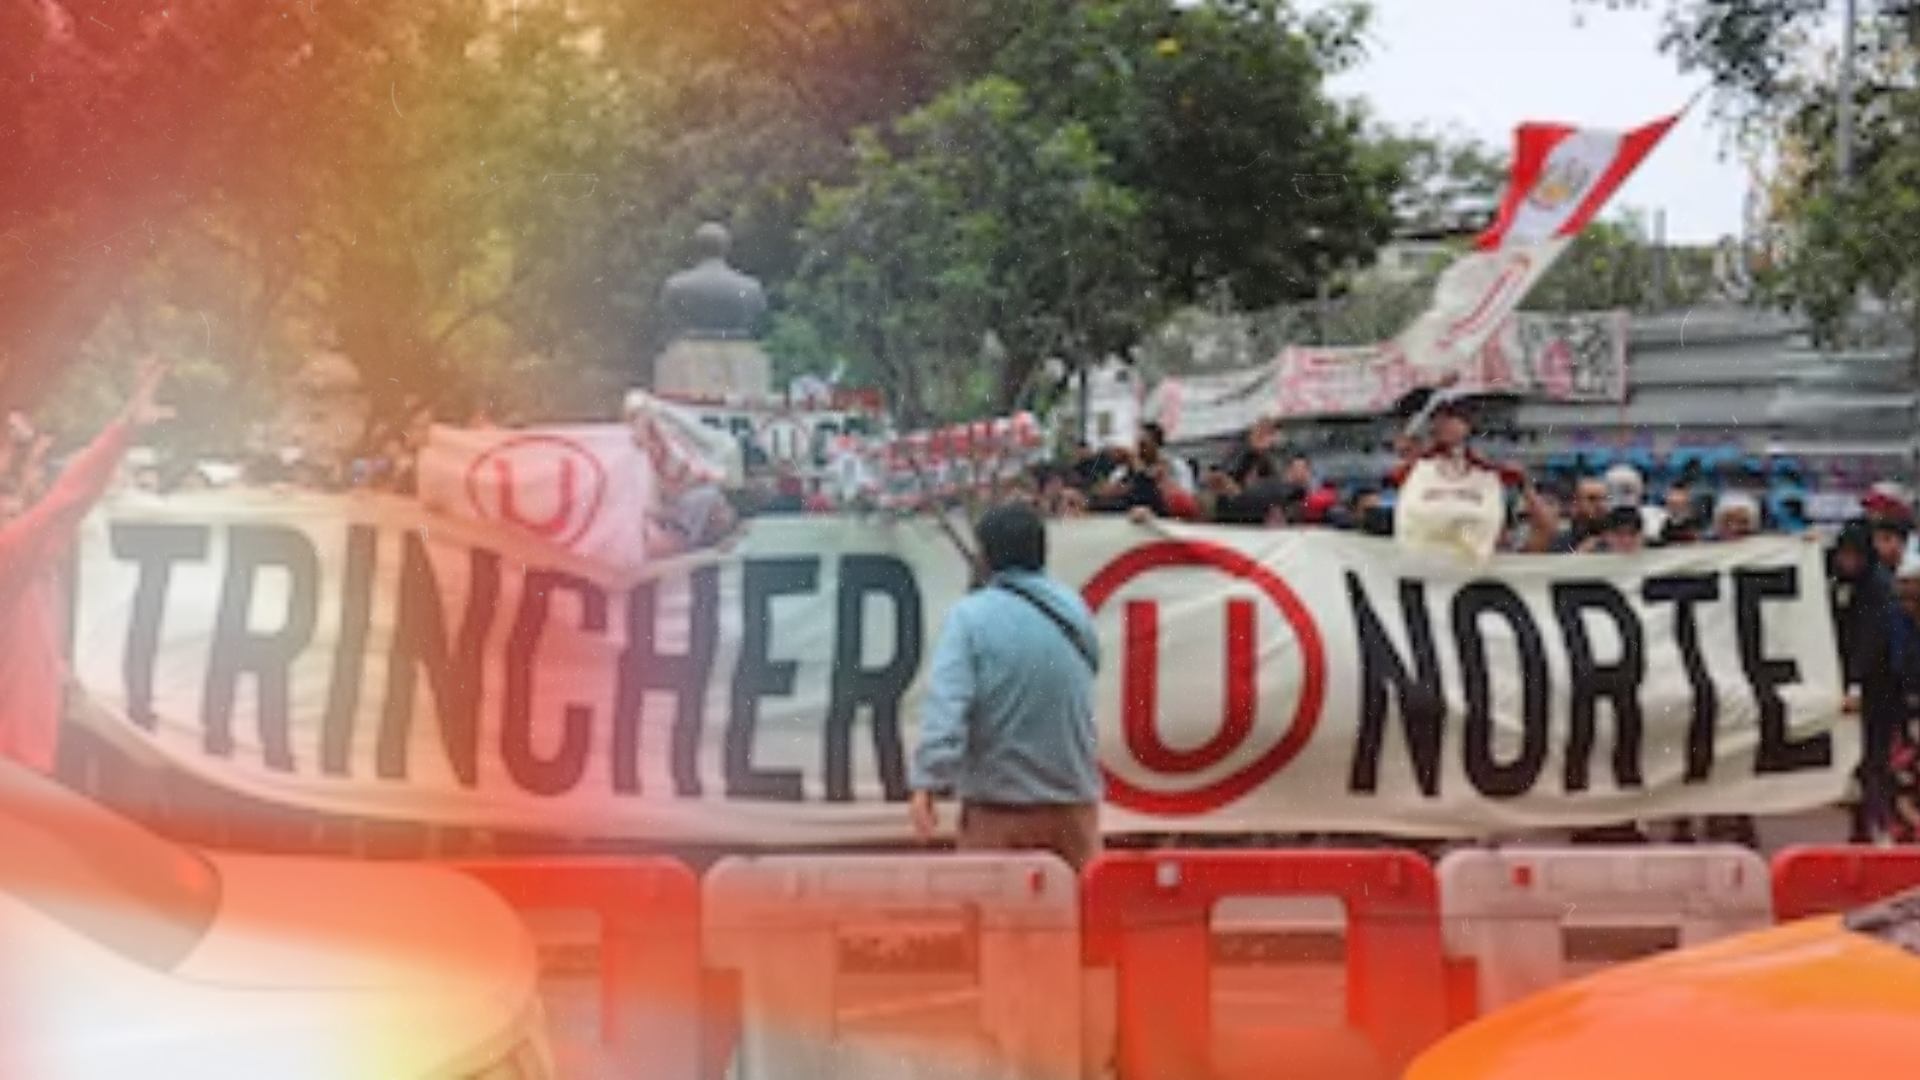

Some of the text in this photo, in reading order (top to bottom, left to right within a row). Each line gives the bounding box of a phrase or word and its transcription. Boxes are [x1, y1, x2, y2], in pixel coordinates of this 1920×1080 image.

[496, 456, 576, 533] U
[109, 521, 1832, 799] TRINCHER U NORTE
